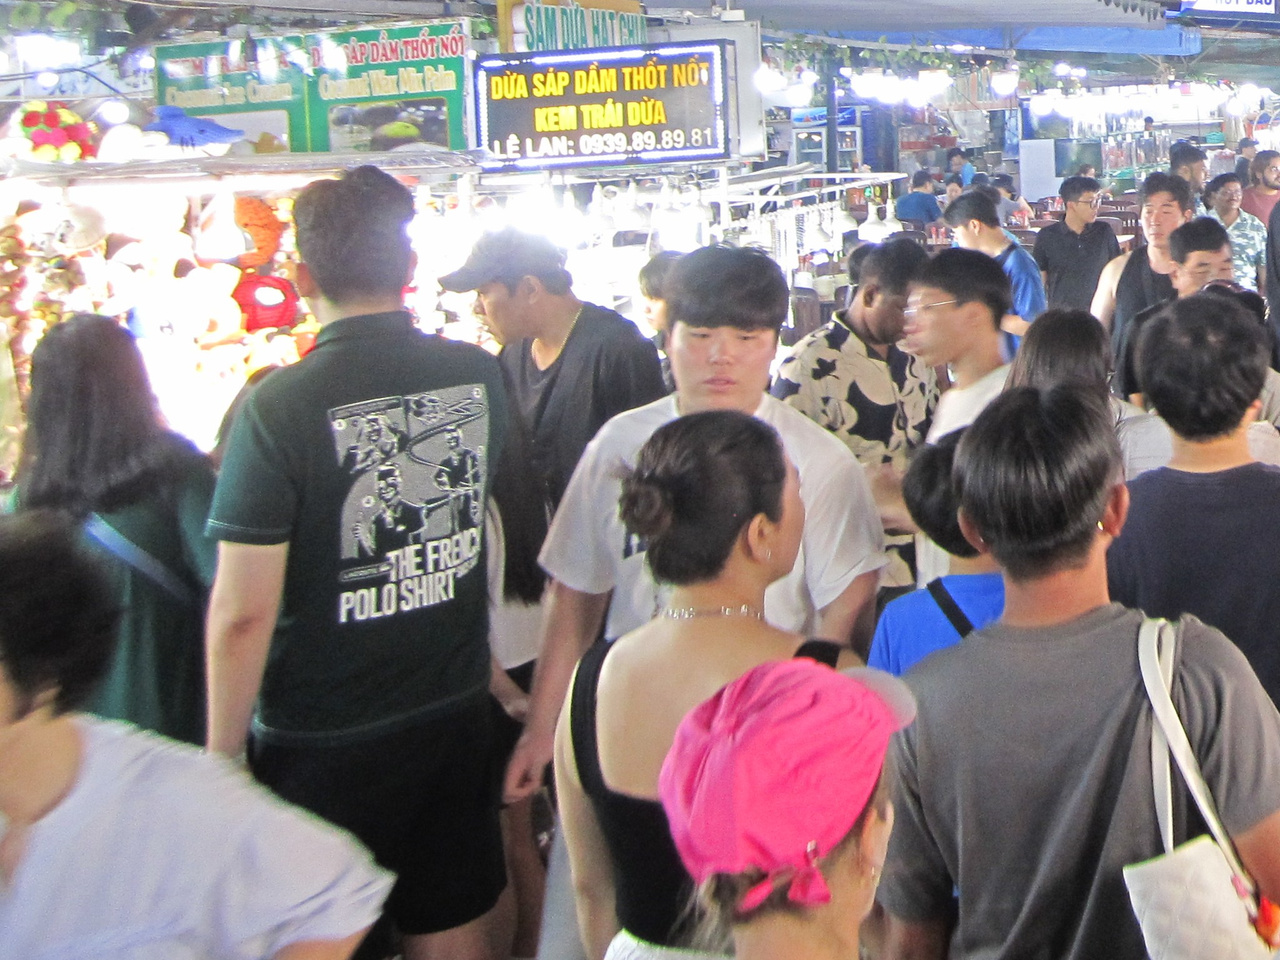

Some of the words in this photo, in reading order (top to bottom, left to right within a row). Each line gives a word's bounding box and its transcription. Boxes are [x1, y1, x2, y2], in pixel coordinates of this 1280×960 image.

[490, 70, 529, 100] DỪA
[621, 56, 668, 91] THỐT
[672, 54, 710, 87] NỐT
[534, 104, 578, 133] KEM
[580, 97, 625, 129] TRÁI
[627, 96, 667, 126] DỪA
[493, 134, 521, 160] LÊ
[525, 135, 576, 158] LAN:
[578, 127, 713, 155] 0939.89.89.81
[386, 543, 423, 582] THE
[339, 582, 398, 624] POLO
[400, 569, 458, 612] SHIRT
